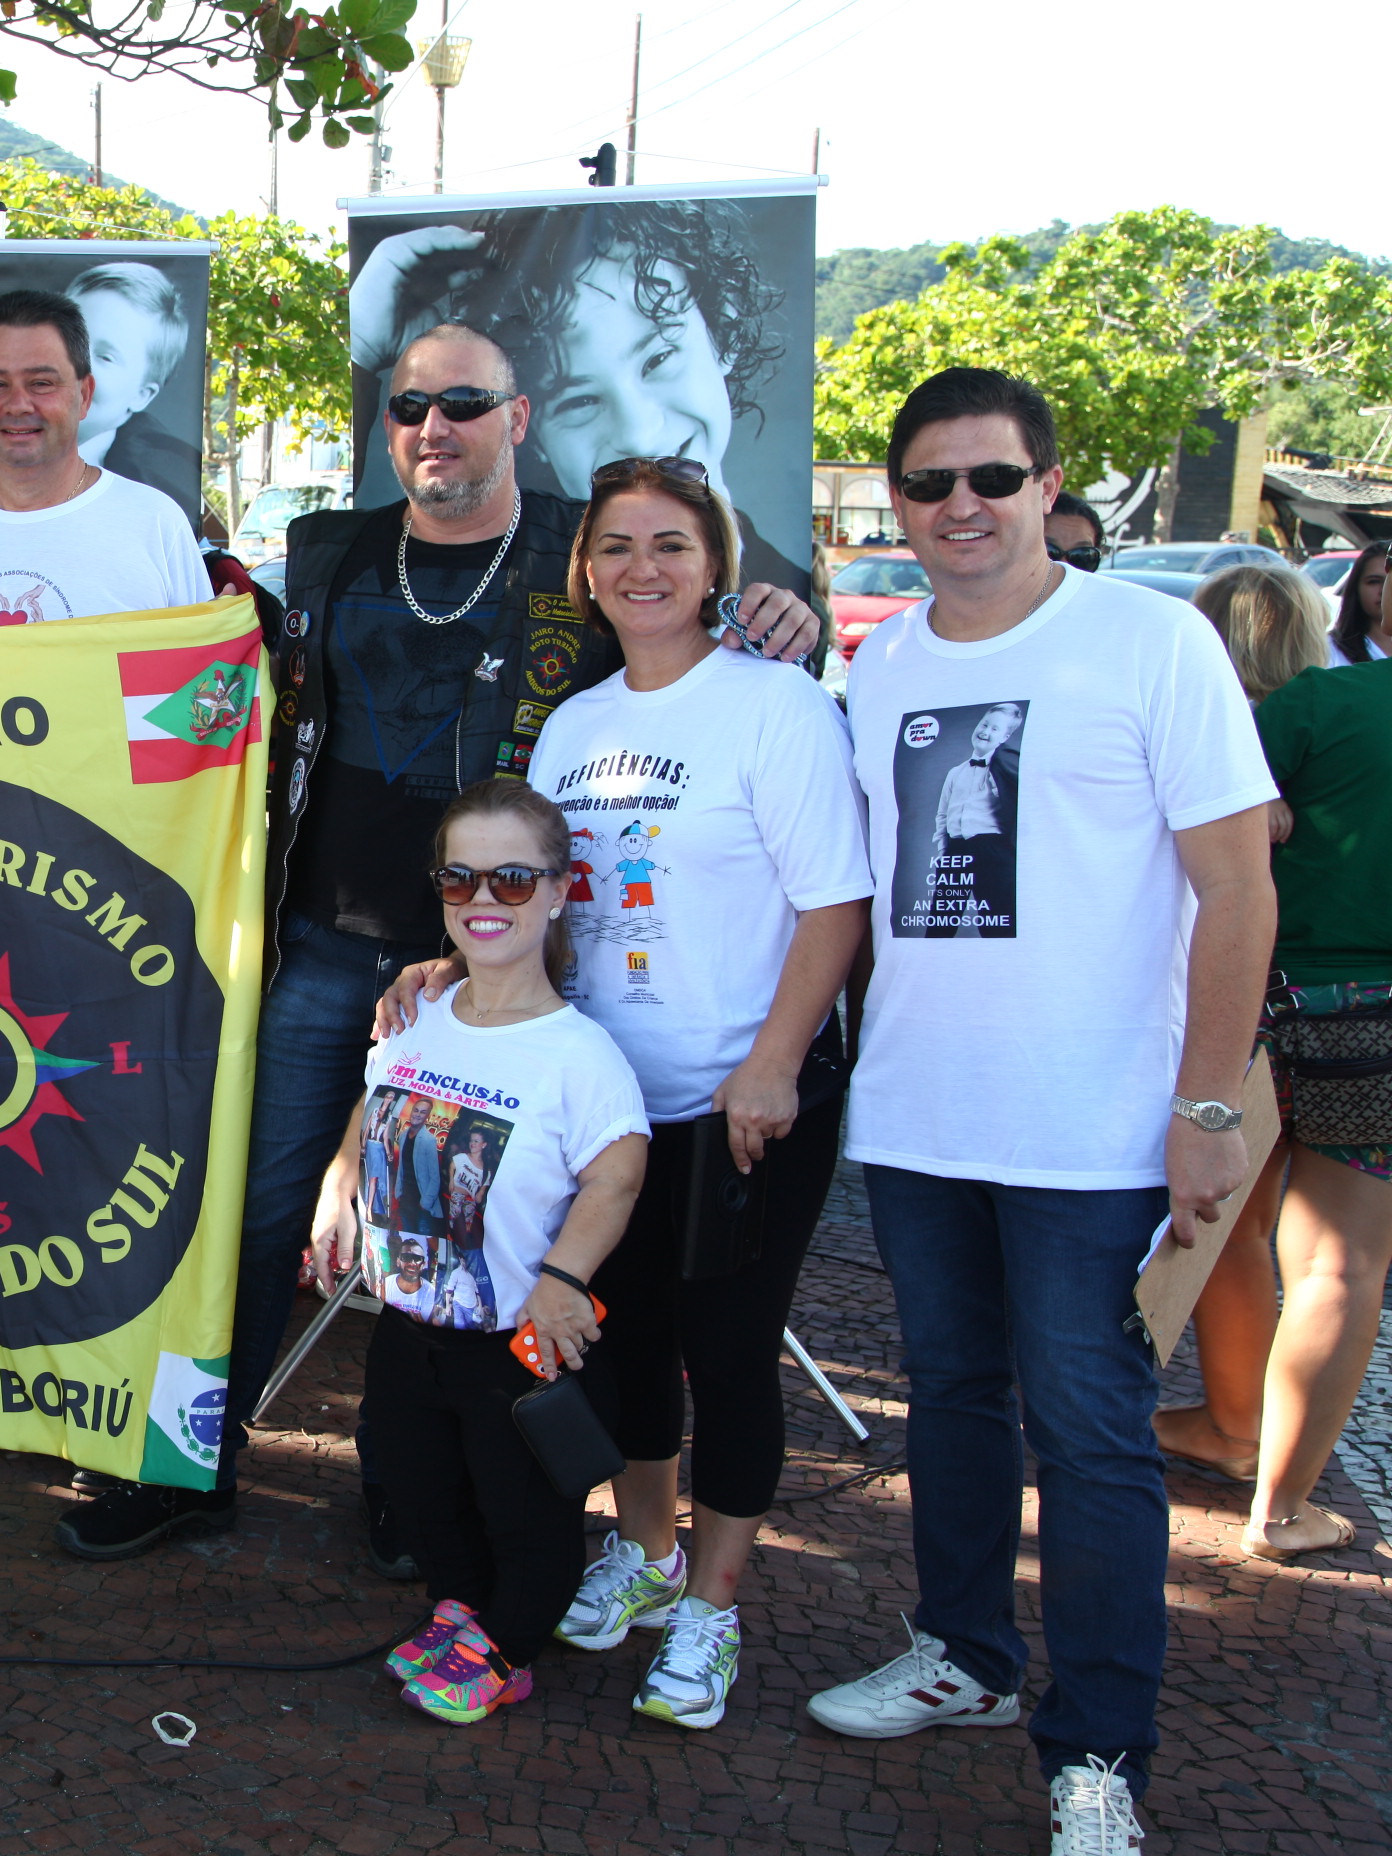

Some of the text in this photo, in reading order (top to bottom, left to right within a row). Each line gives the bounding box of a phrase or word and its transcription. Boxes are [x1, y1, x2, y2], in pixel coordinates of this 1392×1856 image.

[3, 569, 45, 581] ASSOCIAÇÕES
[44, 578, 54, 587] DE
[52, 585, 72, 613] SÍNDROME
[530, 627, 554, 640] JAIRO
[529, 637, 578, 664] MOTO TURISMO
[525, 670, 546, 696] AMIGOS
[557, 679, 571, 692] SUL
[556, 750, 690, 796] DEFICIÊNCIAS:
[594, 795, 601, 811] é
[601, 798, 609, 811] a
[609, 795, 642, 811] melhor
[642, 794, 681, 813] opção!
[929, 855, 974, 869] KEEP
[926, 872, 974, 886] CALM
[913, 899, 990, 911] AN EXTRA
[927, 889, 972, 897] IT'S ONLY
[901, 915, 1010, 927] CHROMOSOME
[108, 1041, 142, 1075] L
[389, 1076, 489, 1110] UZ, MODA & ARTE
[417, 1071, 520, 1109] INCLUSÃO
[86, 1143, 185, 1264] SUL
